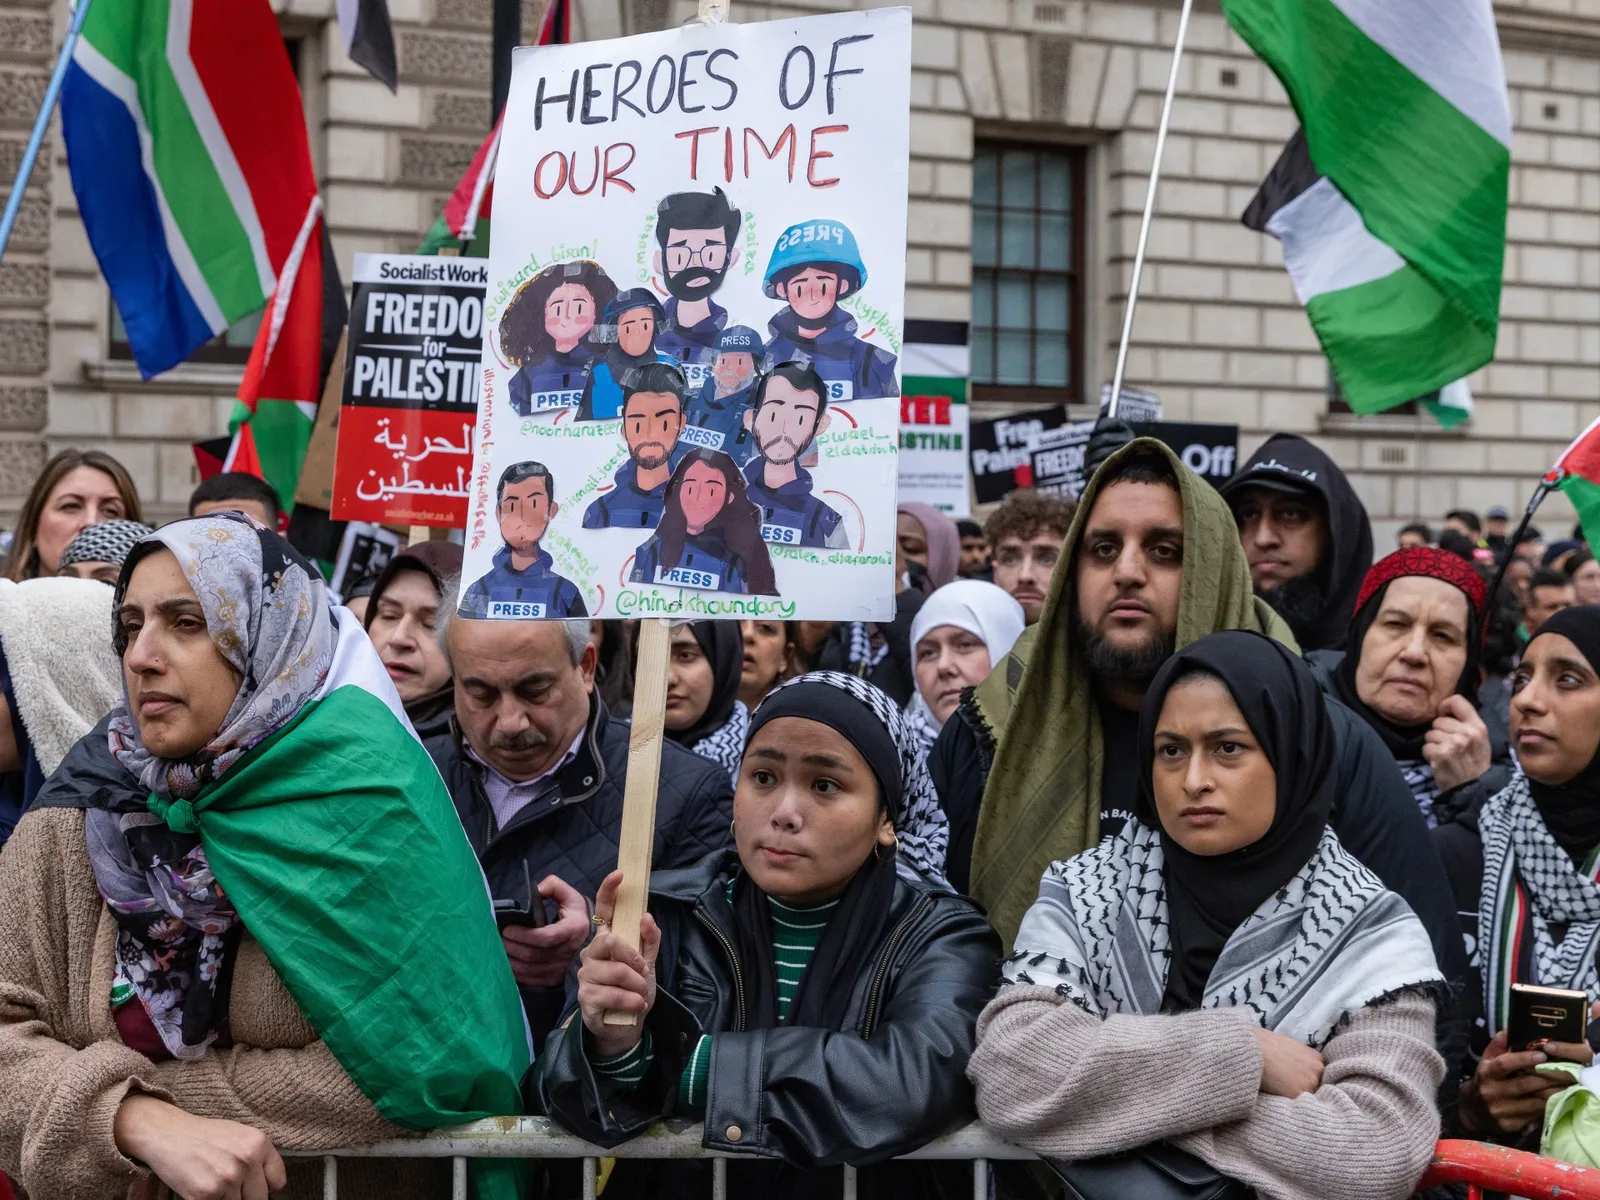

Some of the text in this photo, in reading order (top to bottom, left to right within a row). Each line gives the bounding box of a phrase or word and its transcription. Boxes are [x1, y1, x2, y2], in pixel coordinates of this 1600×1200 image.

[534, 34, 875, 130] HEROES OF
[534, 123, 850, 199] OUR TIME
[380, 262, 445, 281] Socialist
[364, 291, 486, 340] FREEDO
[422, 336, 447, 358] for
[720, 335, 751, 347] PRESS
[1181, 443, 1236, 478] Off
[660, 569, 713, 588] PRESS
[492, 603, 541, 617] PRESS
